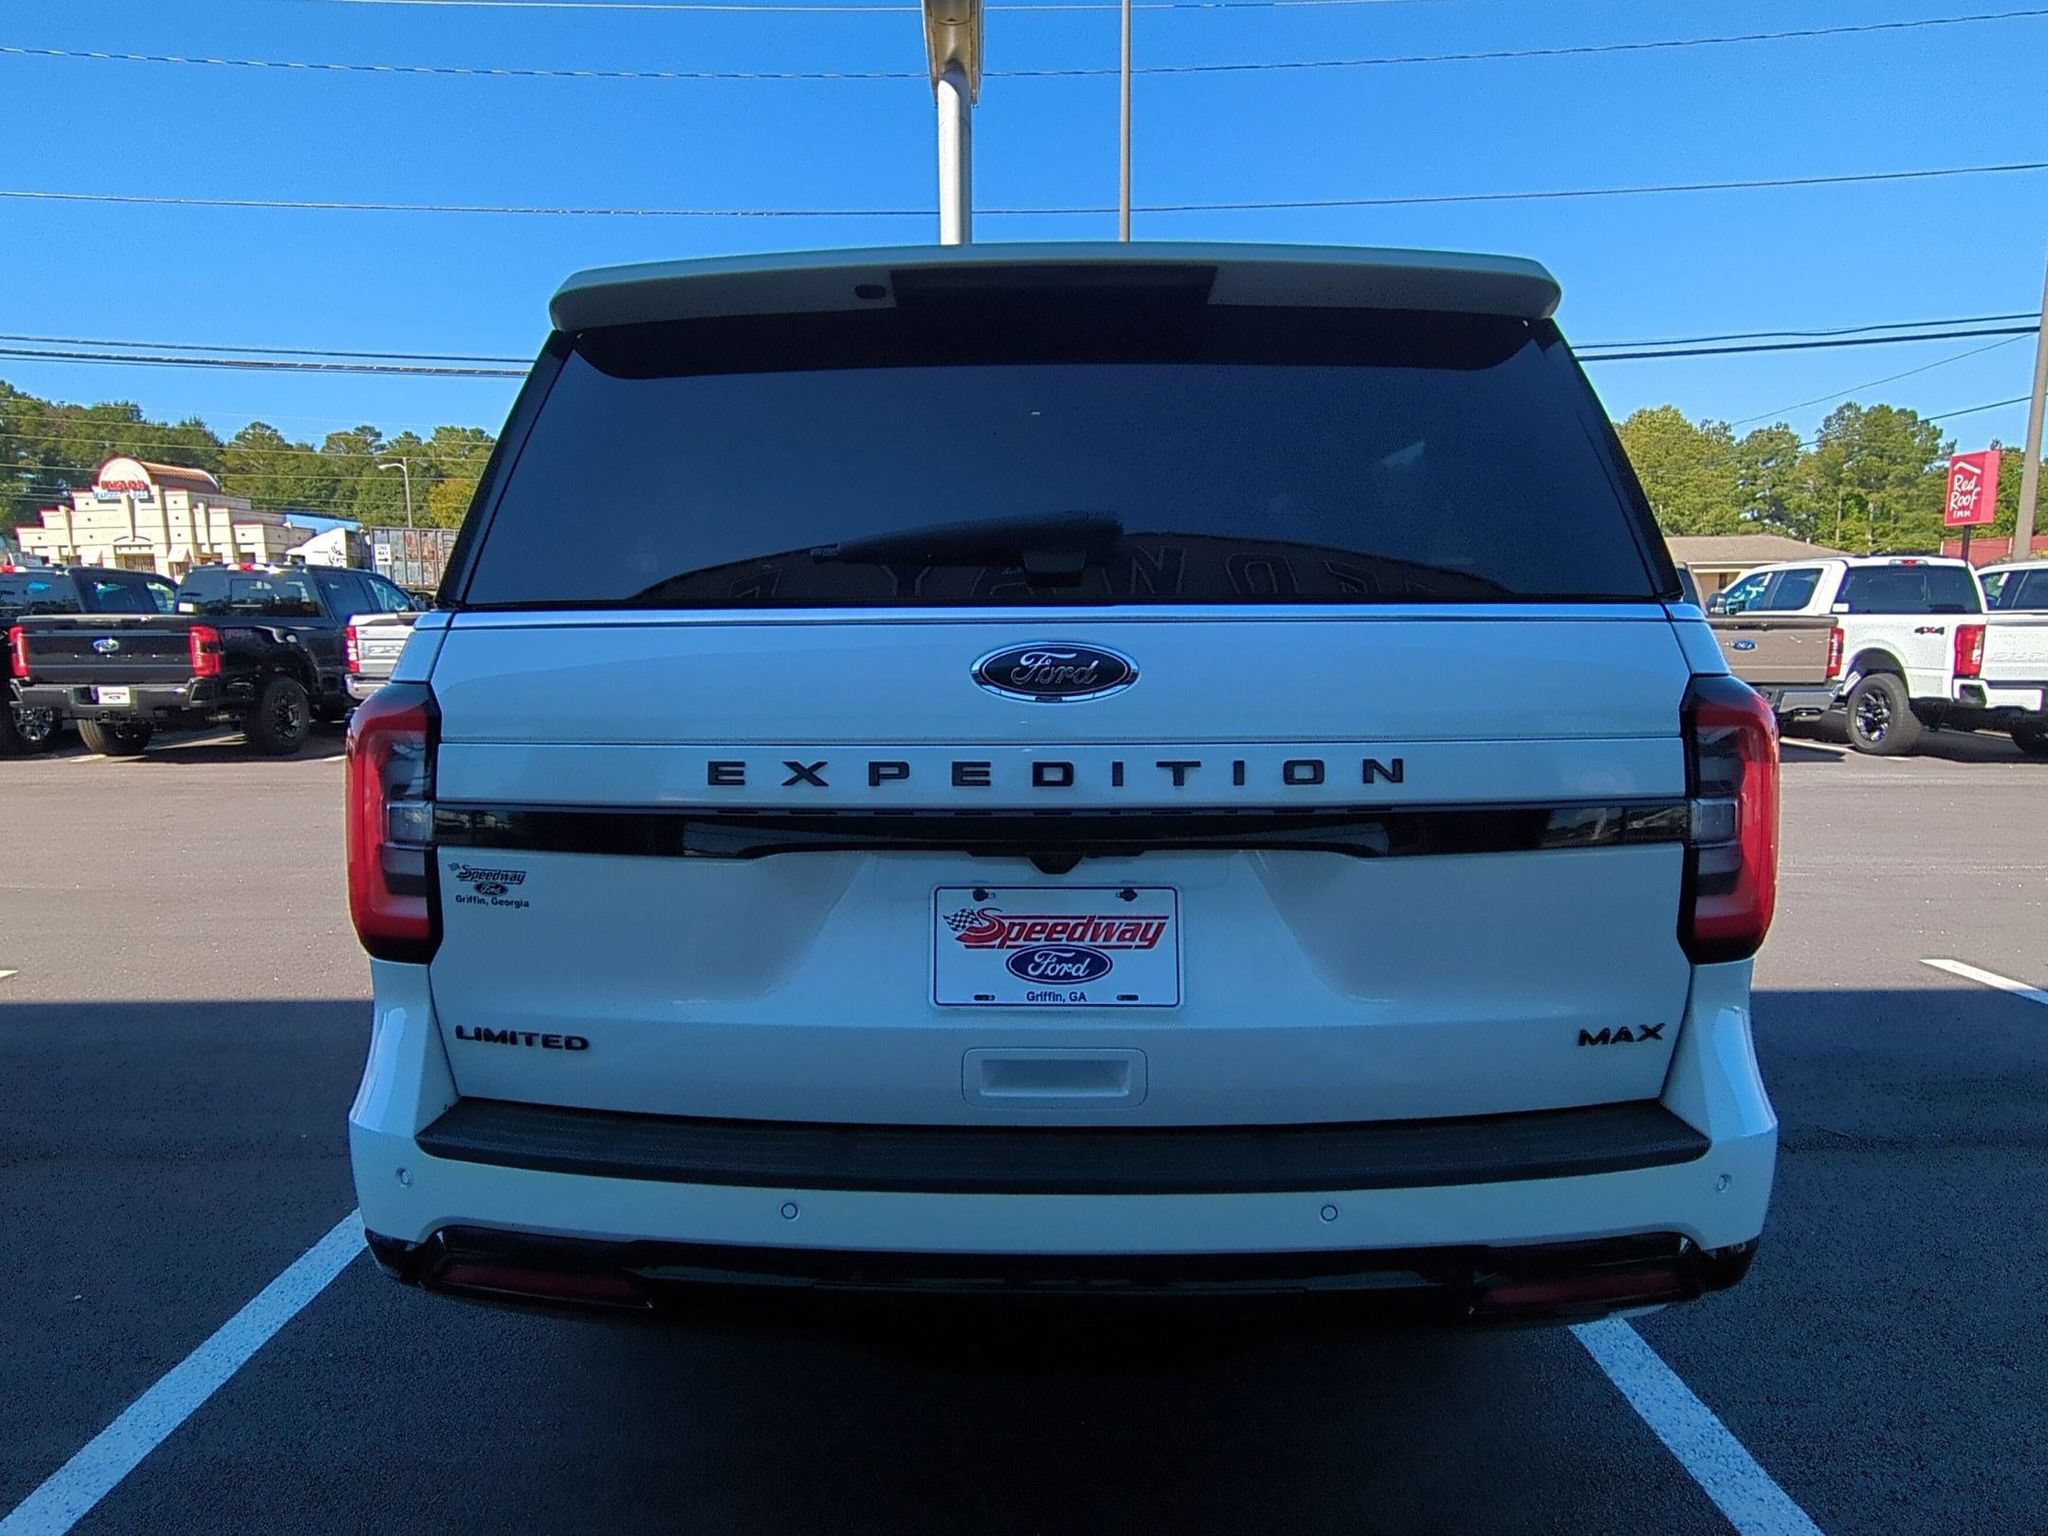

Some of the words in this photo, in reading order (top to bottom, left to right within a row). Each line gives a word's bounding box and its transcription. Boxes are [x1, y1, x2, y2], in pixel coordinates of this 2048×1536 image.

[1953, 474, 1978, 492] Red
[1948, 486, 1982, 512] Roof
[1010, 651, 1100, 685] Ford
[707, 758, 1405, 788] EXPEDITION
[456, 864, 527, 885] Speedway
[455, 894, 489, 906] Griffin,
[491, 896, 530, 909] Georgia
[955, 907, 1170, 950] Speedway
[1027, 950, 1090, 977] Ford
[1026, 991, 1066, 1003] Griffin,
[1069, 991, 1087, 1002] GA
[455, 1025, 590, 1051] LIMITED
[1577, 1022, 1667, 1047] MAX
